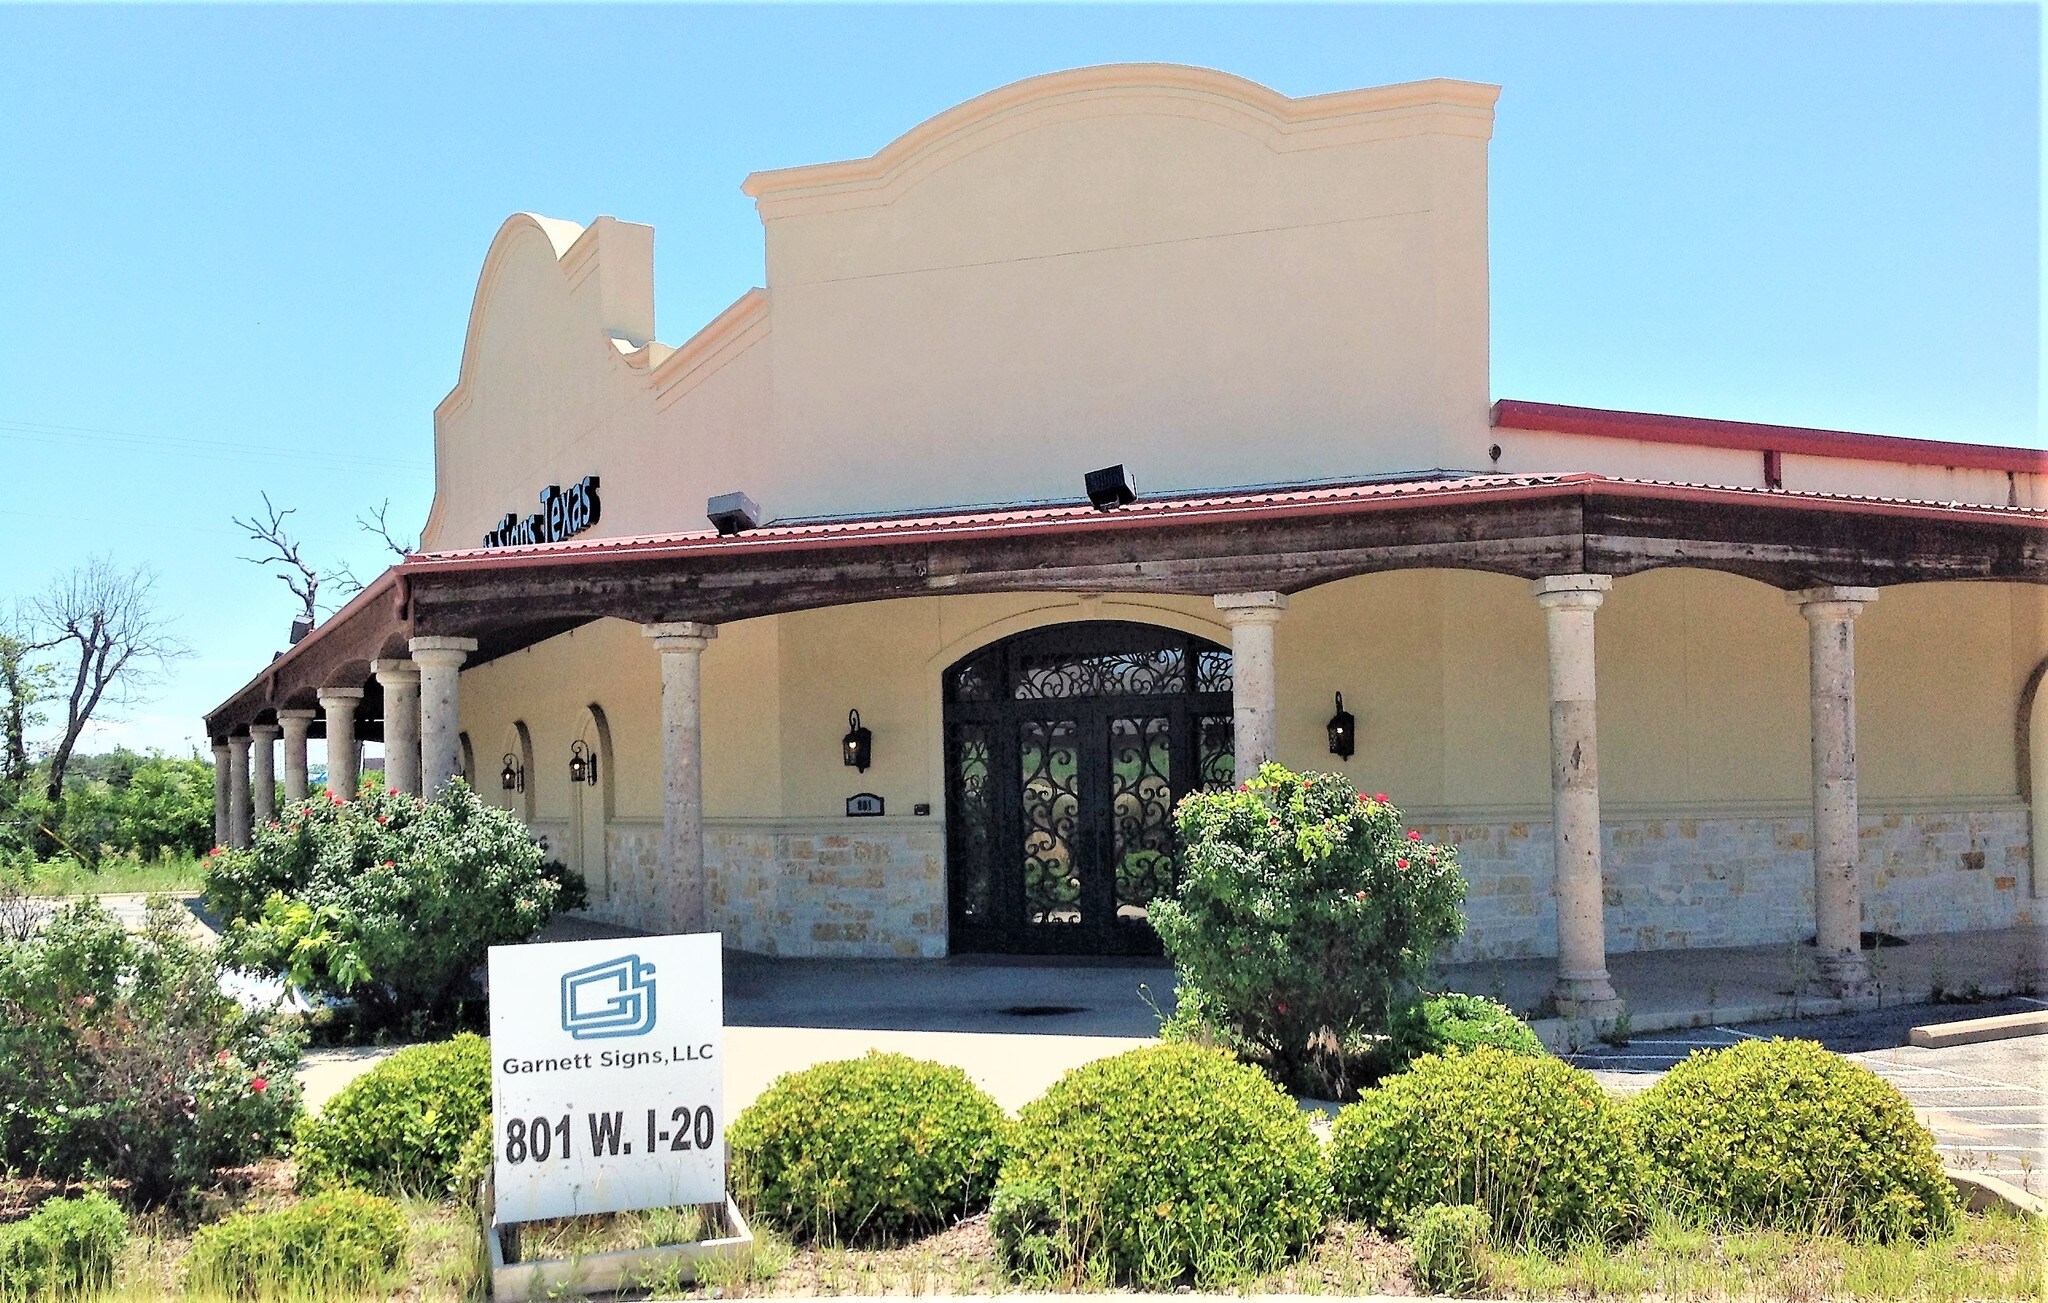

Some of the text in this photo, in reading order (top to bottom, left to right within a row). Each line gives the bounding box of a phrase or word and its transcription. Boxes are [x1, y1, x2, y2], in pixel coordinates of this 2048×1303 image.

[540, 475, 601, 542] Texas
[502, 1043, 714, 1074] Garnett Signs, LLC
[506, 1105, 715, 1164] 801 W. I-20
